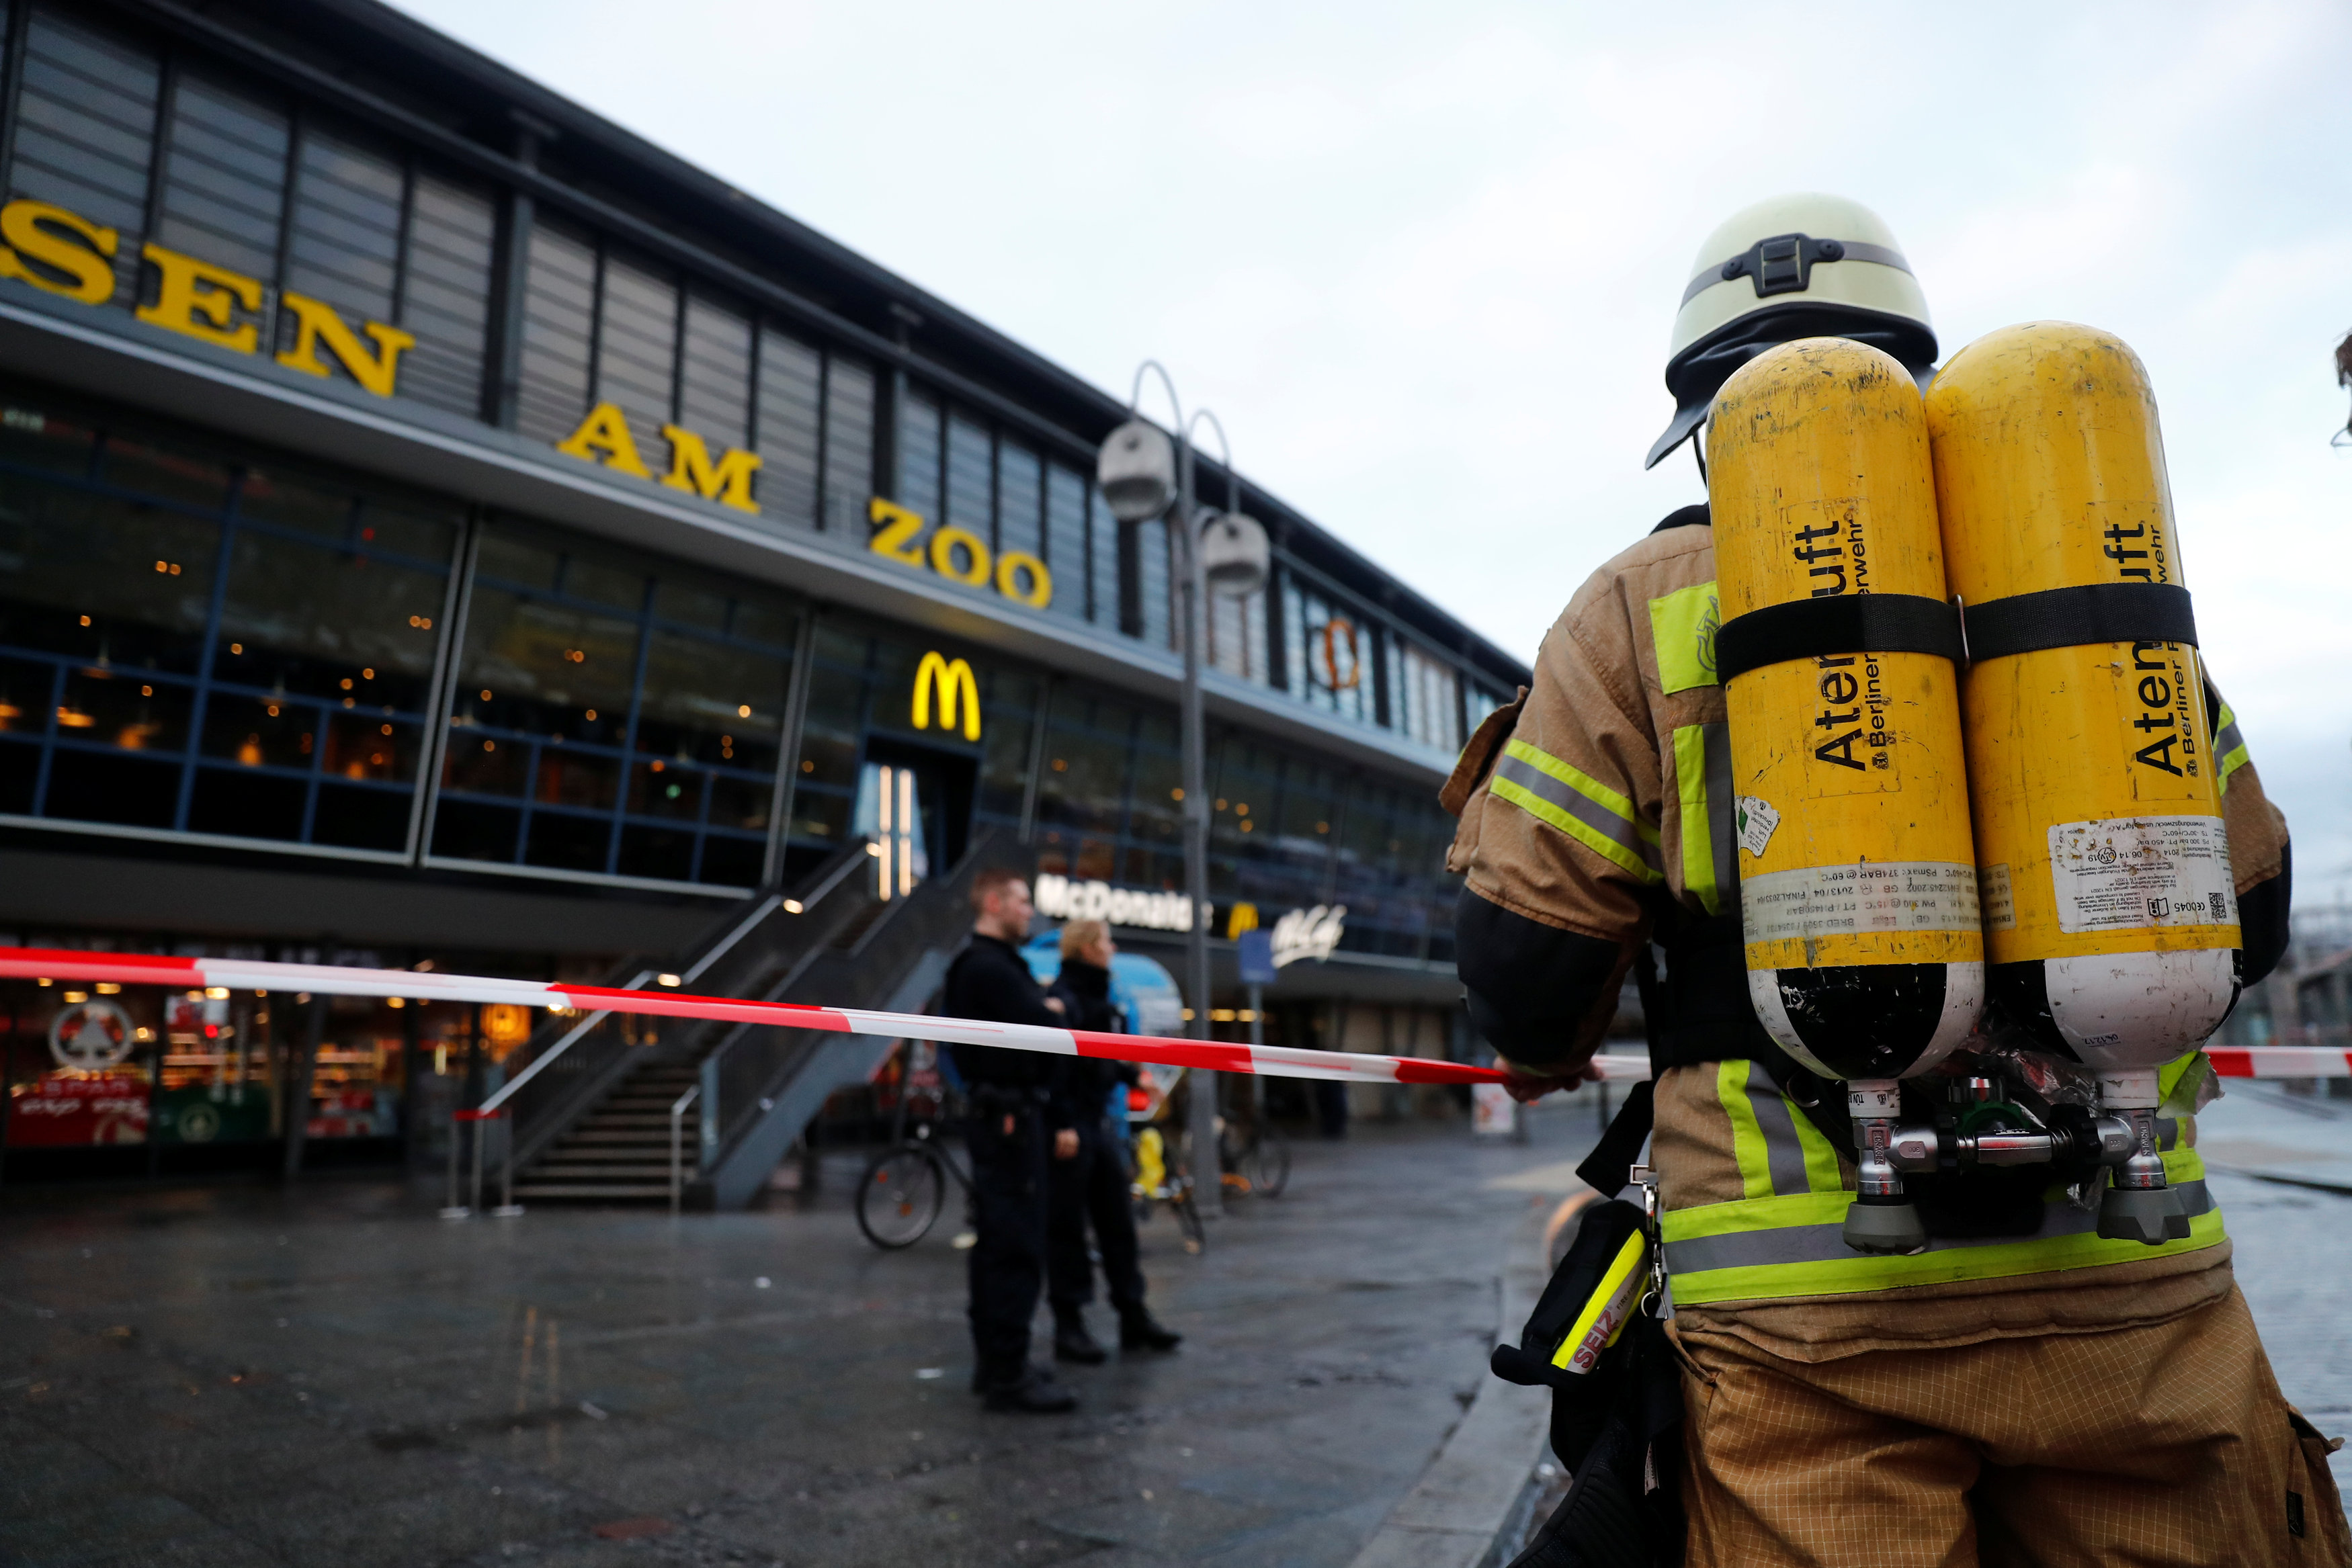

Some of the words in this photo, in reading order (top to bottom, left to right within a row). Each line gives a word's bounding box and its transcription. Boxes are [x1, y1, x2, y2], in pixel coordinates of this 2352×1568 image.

[0, 199, 415, 398] SEN
[557, 401, 762, 515] AM
[870, 496, 1052, 609] ZOO
[1863, 654, 1886, 747] Berliner
[2171, 660, 2195, 754] Berliner
[1820, 873, 1844, 882] 60°C
[1847, 870, 1857, 880] @
[1884, 885, 1898, 893] GB
[1891, 898, 1900, 908] @
[1917, 915, 1929, 923] GB
